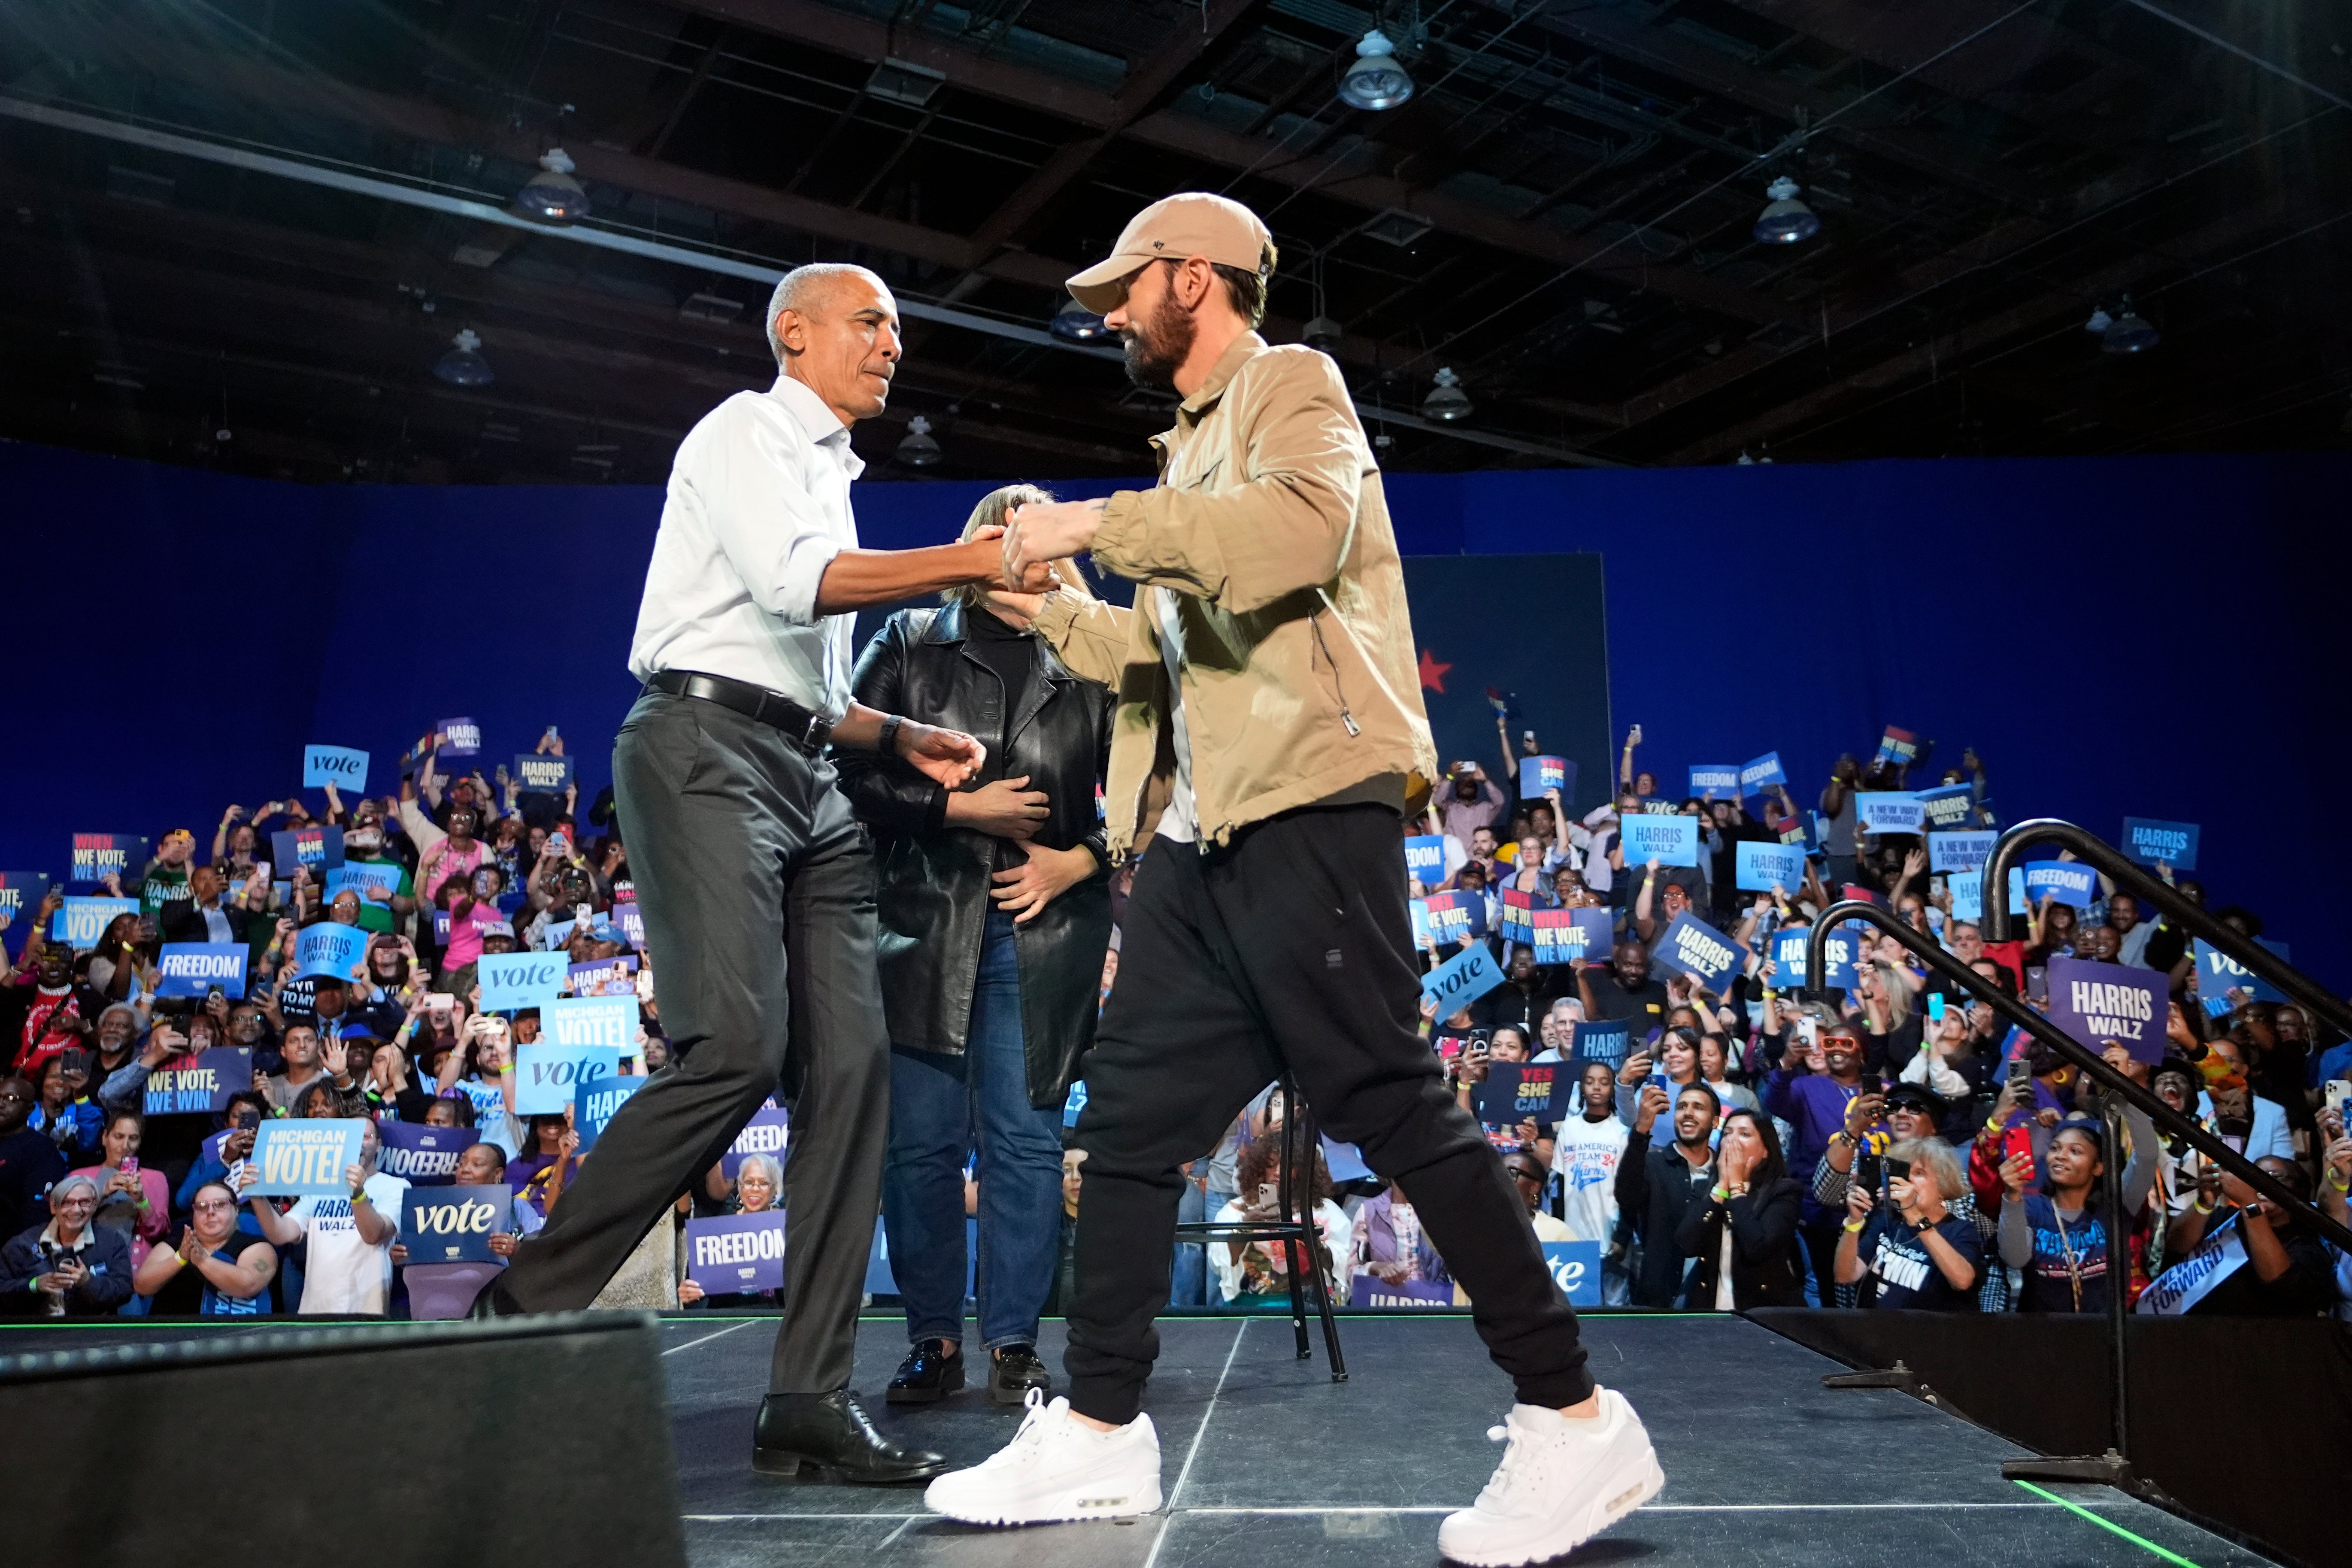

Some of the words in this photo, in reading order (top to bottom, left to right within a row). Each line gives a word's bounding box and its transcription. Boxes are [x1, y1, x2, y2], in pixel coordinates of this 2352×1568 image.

[312, 755, 360, 773] vote
[521, 761, 565, 779] HARRIS
[527, 776, 558, 786] WALZ
[1692, 773, 1736, 786] FREEDOM
[1868, 805, 1874, 813] A
[1877, 805, 1897, 814] NEW
[1900, 806, 1919, 815] WAY
[1933, 812, 1964, 826] WALZ
[1872, 815, 1916, 825] FORWARD
[75, 835, 113, 849] WHEN
[1636, 827, 1682, 847] HARRIS
[1938, 841, 1943, 852] A
[1946, 840, 1967, 852] NEW
[2132, 826, 2188, 850] HARRIS
[1643, 844, 1674, 852] WALZ
[2139, 846, 2177, 859] WALZ
[74, 849, 94, 865] WE
[97, 849, 127, 869] VOTE,
[1751, 854, 1793, 872] HARRIS
[73, 864, 94, 880] WE
[1757, 870, 1786, 880] WALZ
[2027, 869, 2089, 892] FREEDOM
[67, 904, 128, 913] MICHIGAN
[1440, 907, 1473, 926] VOTE,
[1503, 904, 1518, 923] WE
[1532, 910, 1570, 928] WHEN
[1503, 921, 1516, 940] WE
[1533, 928, 1555, 946] WE
[1555, 926, 1590, 946] VOTE,
[303, 934, 352, 955] HARRIS
[1675, 923, 1735, 971] HARRIS
[308, 952, 342, 964] WALZ
[1534, 945, 1555, 963] WE
[1677, 946, 1718, 978] WALZ
[162, 954, 240, 978] FREEDOM
[491, 961, 555, 988] vote
[1430, 957, 1483, 1002] vote
[282, 990, 297, 1004] TO
[297, 993, 316, 1007] MY
[2071, 980, 2153, 1022] HARRIS
[555, 1004, 625, 1019] MICHIGAN
[556, 1016, 626, 1048] VOTE!
[2086, 1016, 2143, 1040] WALZ
[531, 1055, 606, 1086] vote
[1521, 1068, 1554, 1082] YES
[148, 1071, 173, 1093] WE
[176, 1068, 220, 1093] VOTE,
[1517, 1082, 1552, 1098] SHE
[146, 1092, 173, 1113] WE
[176, 1089, 211, 1111] WIN
[1514, 1097, 1551, 1112] CAN
[268, 1130, 347, 1143] MICHIGAN
[1577, 1143, 1617, 1154] AMERICA
[265, 1143, 344, 1184] VOTE!
[414, 1197, 496, 1234] vote
[319, 1219, 356, 1231] WALZ
[2151, 1244, 2224, 1314] FORWARD
